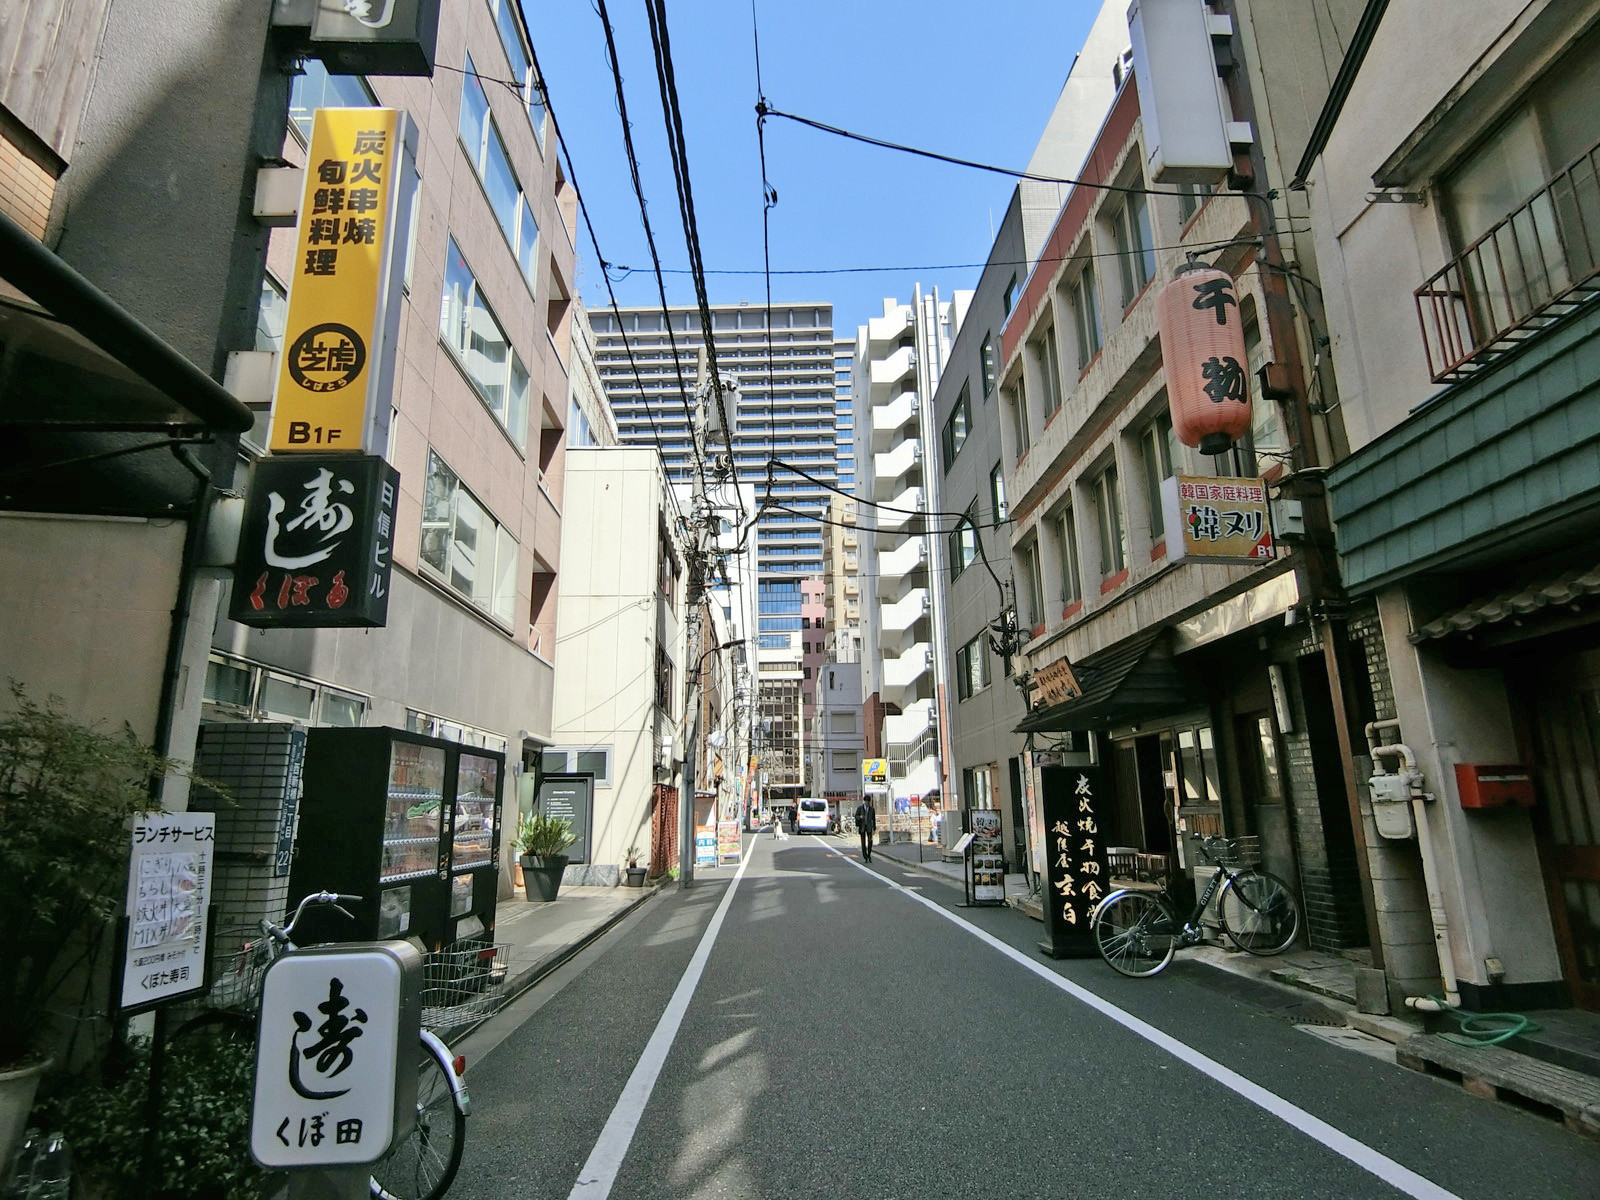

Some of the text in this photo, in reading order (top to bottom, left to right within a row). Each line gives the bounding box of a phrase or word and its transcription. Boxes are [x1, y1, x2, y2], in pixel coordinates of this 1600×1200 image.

[342, 130, 386, 245] 炭火串焼
[304, 159, 348, 277] 旬鮮料理
[1192, 278, 1247, 404] 干物
[289, 421, 342, 444] B1F
[1180, 483, 1263, 503] 韓国家庭料理
[1186, 505, 1263, 541] 韓ヌリ
[1257, 545, 1274, 557] B1
[134, 825, 215, 844] ランチサービス
[278, 850, 289, 866] 22
[141, 966, 190, 989] くぼた寿司
[276, 1111, 363, 1147] くぼ田
